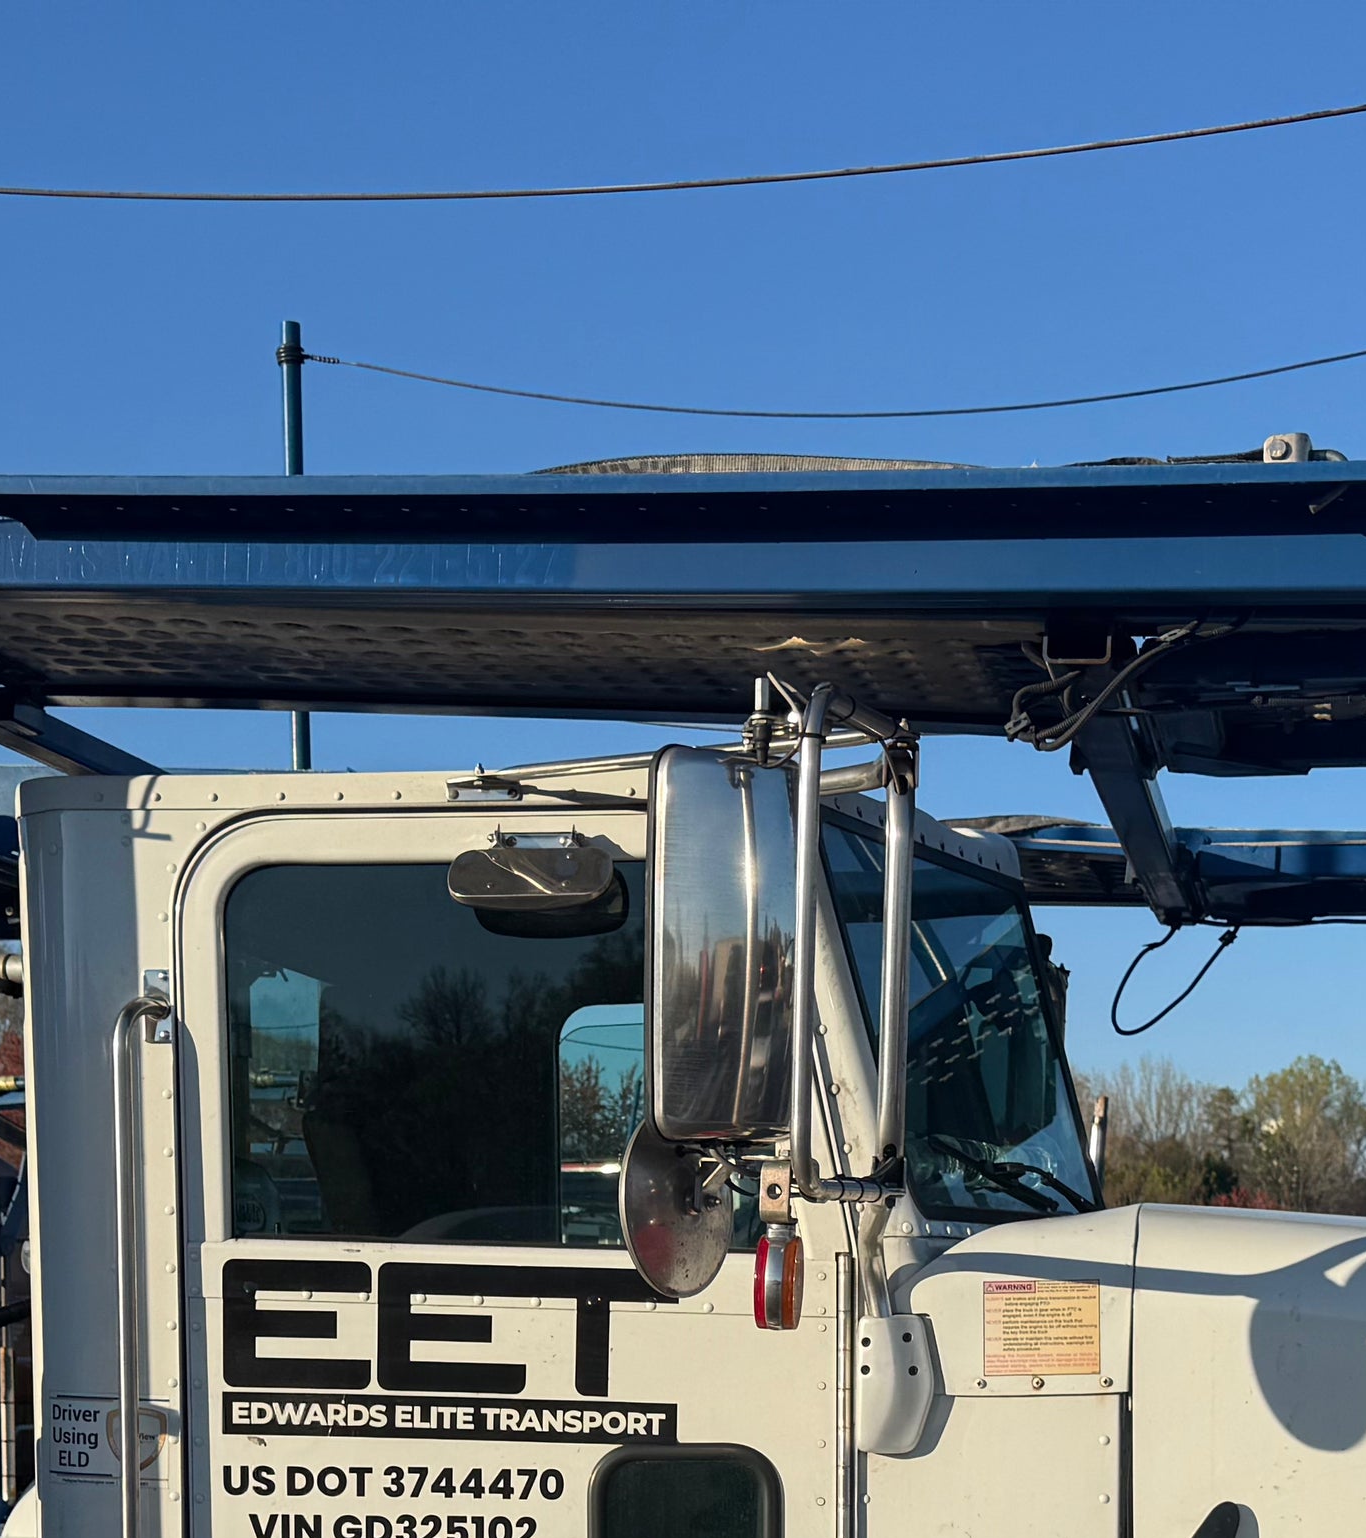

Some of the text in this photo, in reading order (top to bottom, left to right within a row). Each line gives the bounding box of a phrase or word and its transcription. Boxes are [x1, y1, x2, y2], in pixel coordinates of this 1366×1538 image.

[995, 1283, 1033, 1292] WARNING
[222, 1258, 680, 1398] EET
[52, 1403, 100, 1422] Driver
[232, 1400, 667, 1437] EDWARDS ELITE TRANSPORT
[52, 1426, 99, 1449] Using
[58, 1450, 90, 1468] ELD
[222, 1465, 565, 1501] US DOT 3744470
